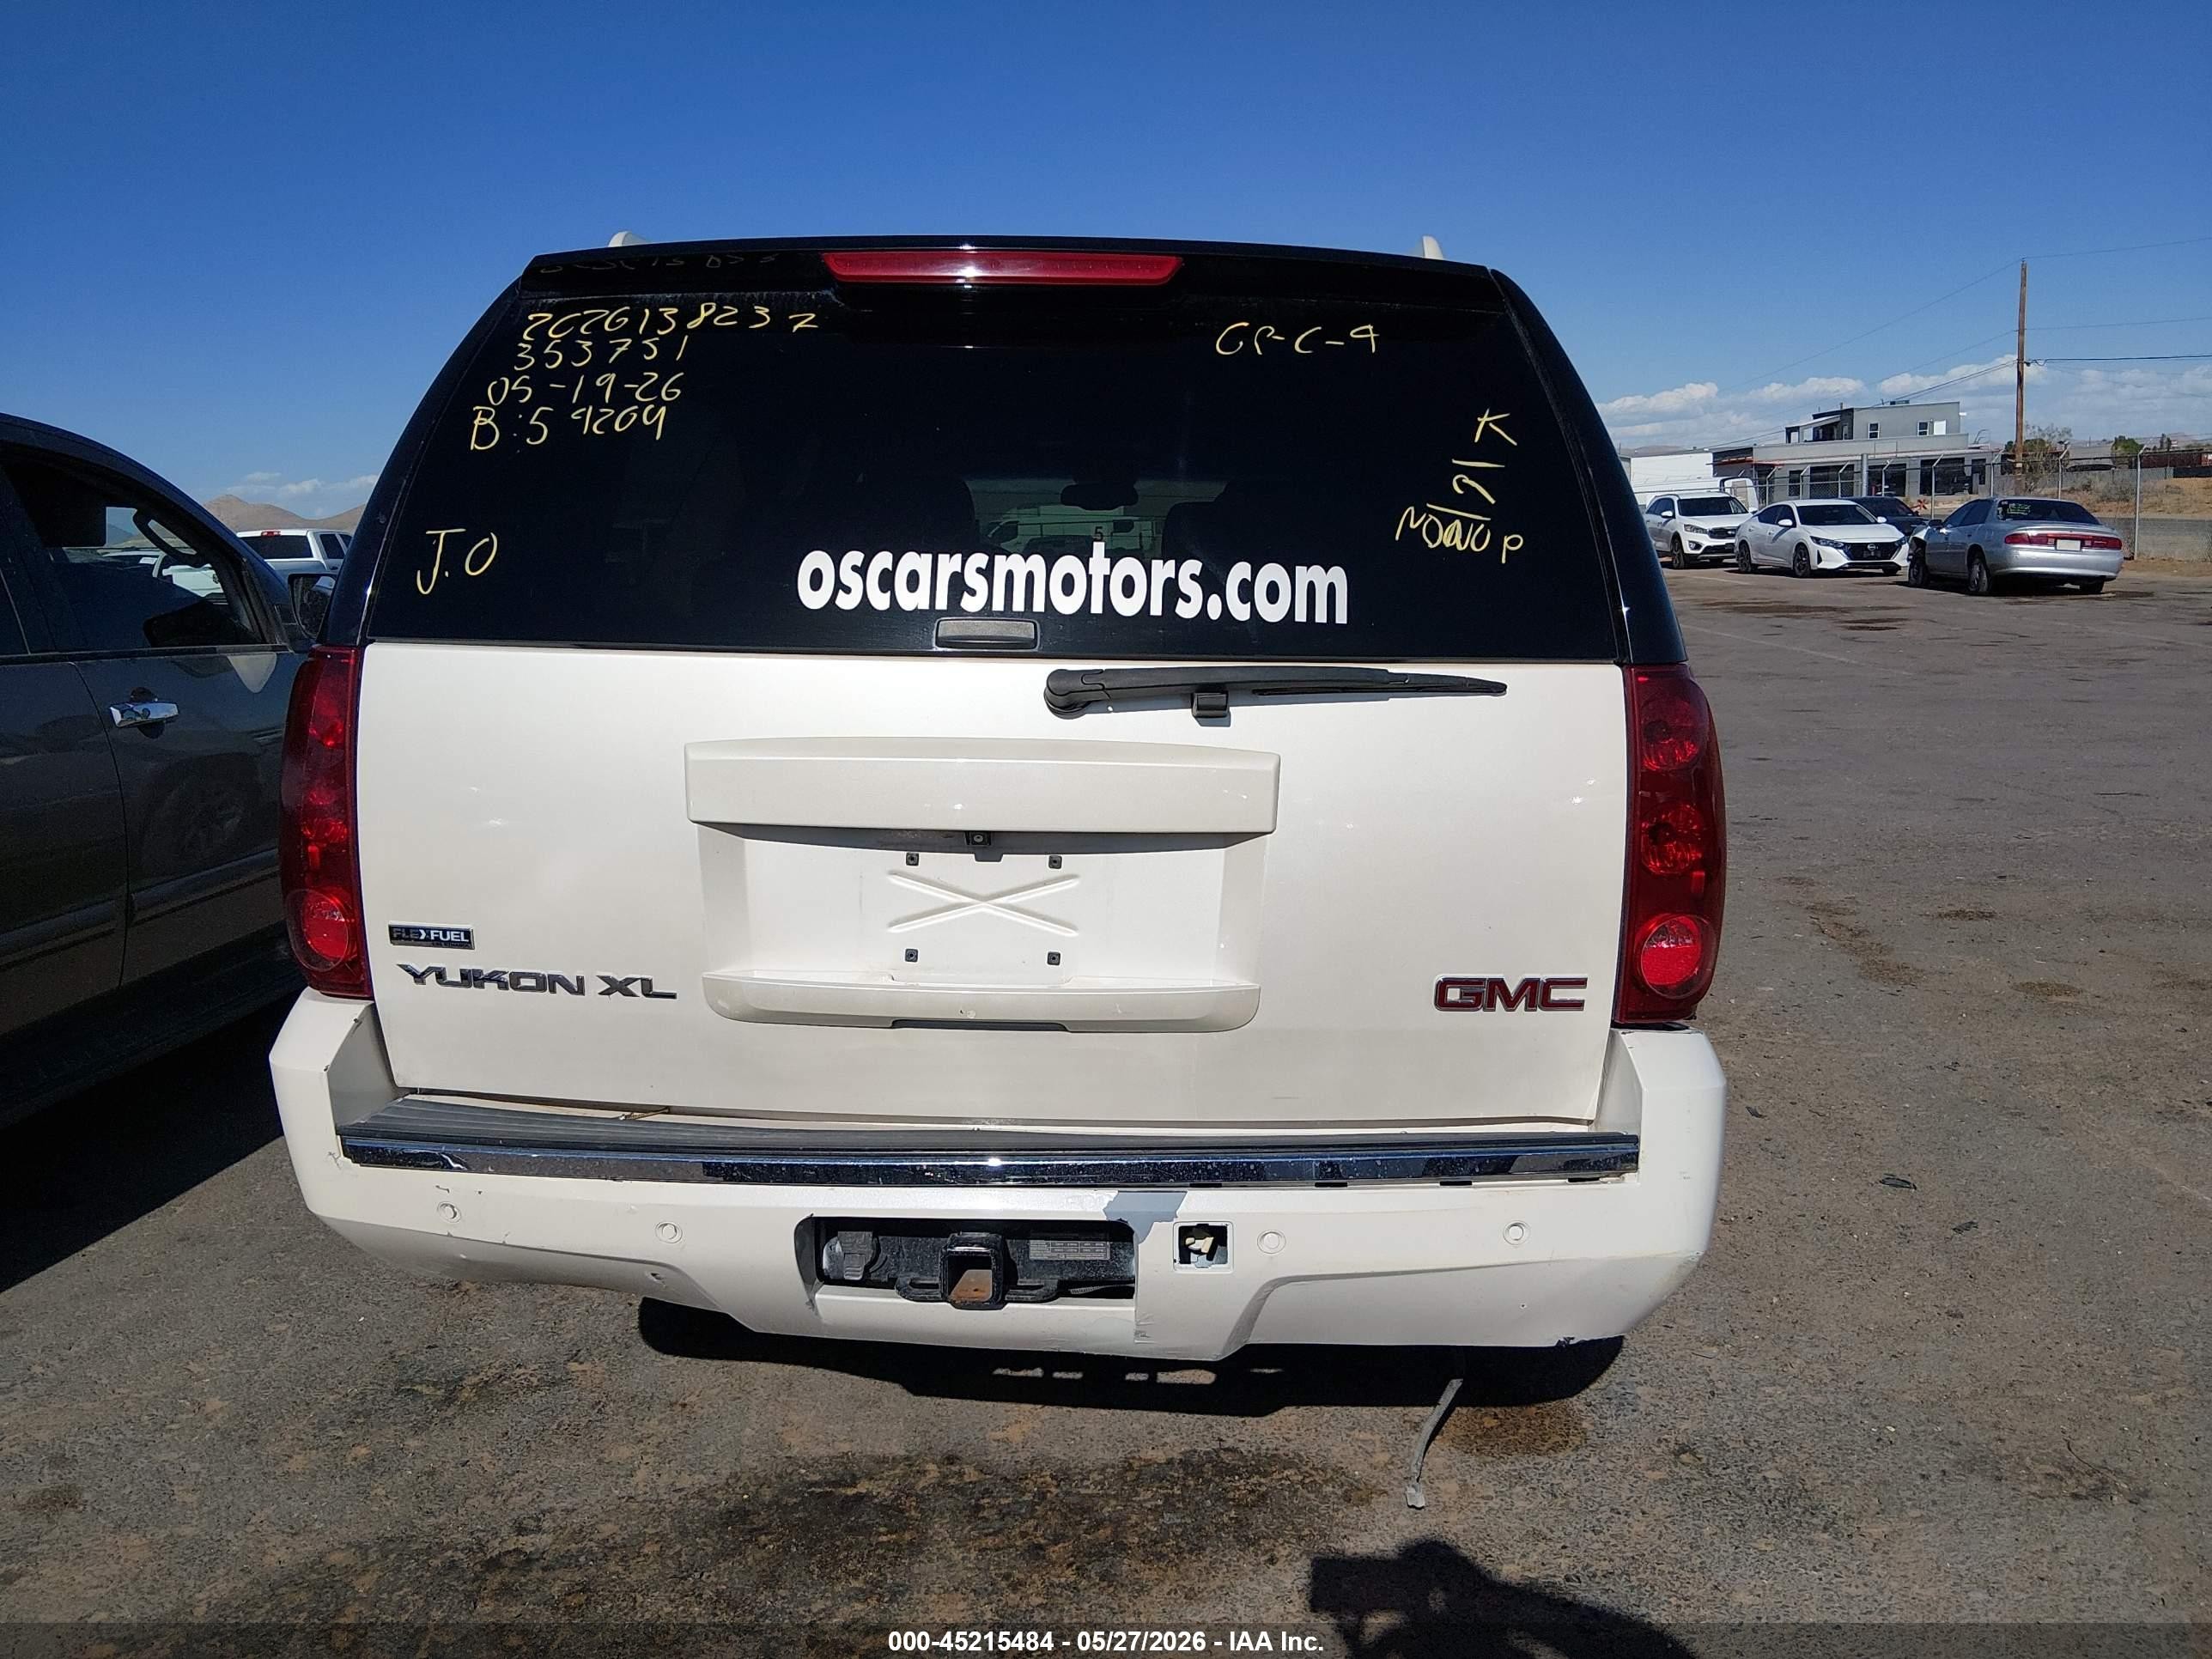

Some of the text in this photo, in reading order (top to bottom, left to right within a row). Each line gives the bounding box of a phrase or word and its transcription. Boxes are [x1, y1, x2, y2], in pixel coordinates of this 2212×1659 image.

[797, 541, 1348, 624] oscarsmotors.com
[396, 963, 678, 1000] YUKON XL
[1433, 976, 1589, 1012] GMC
